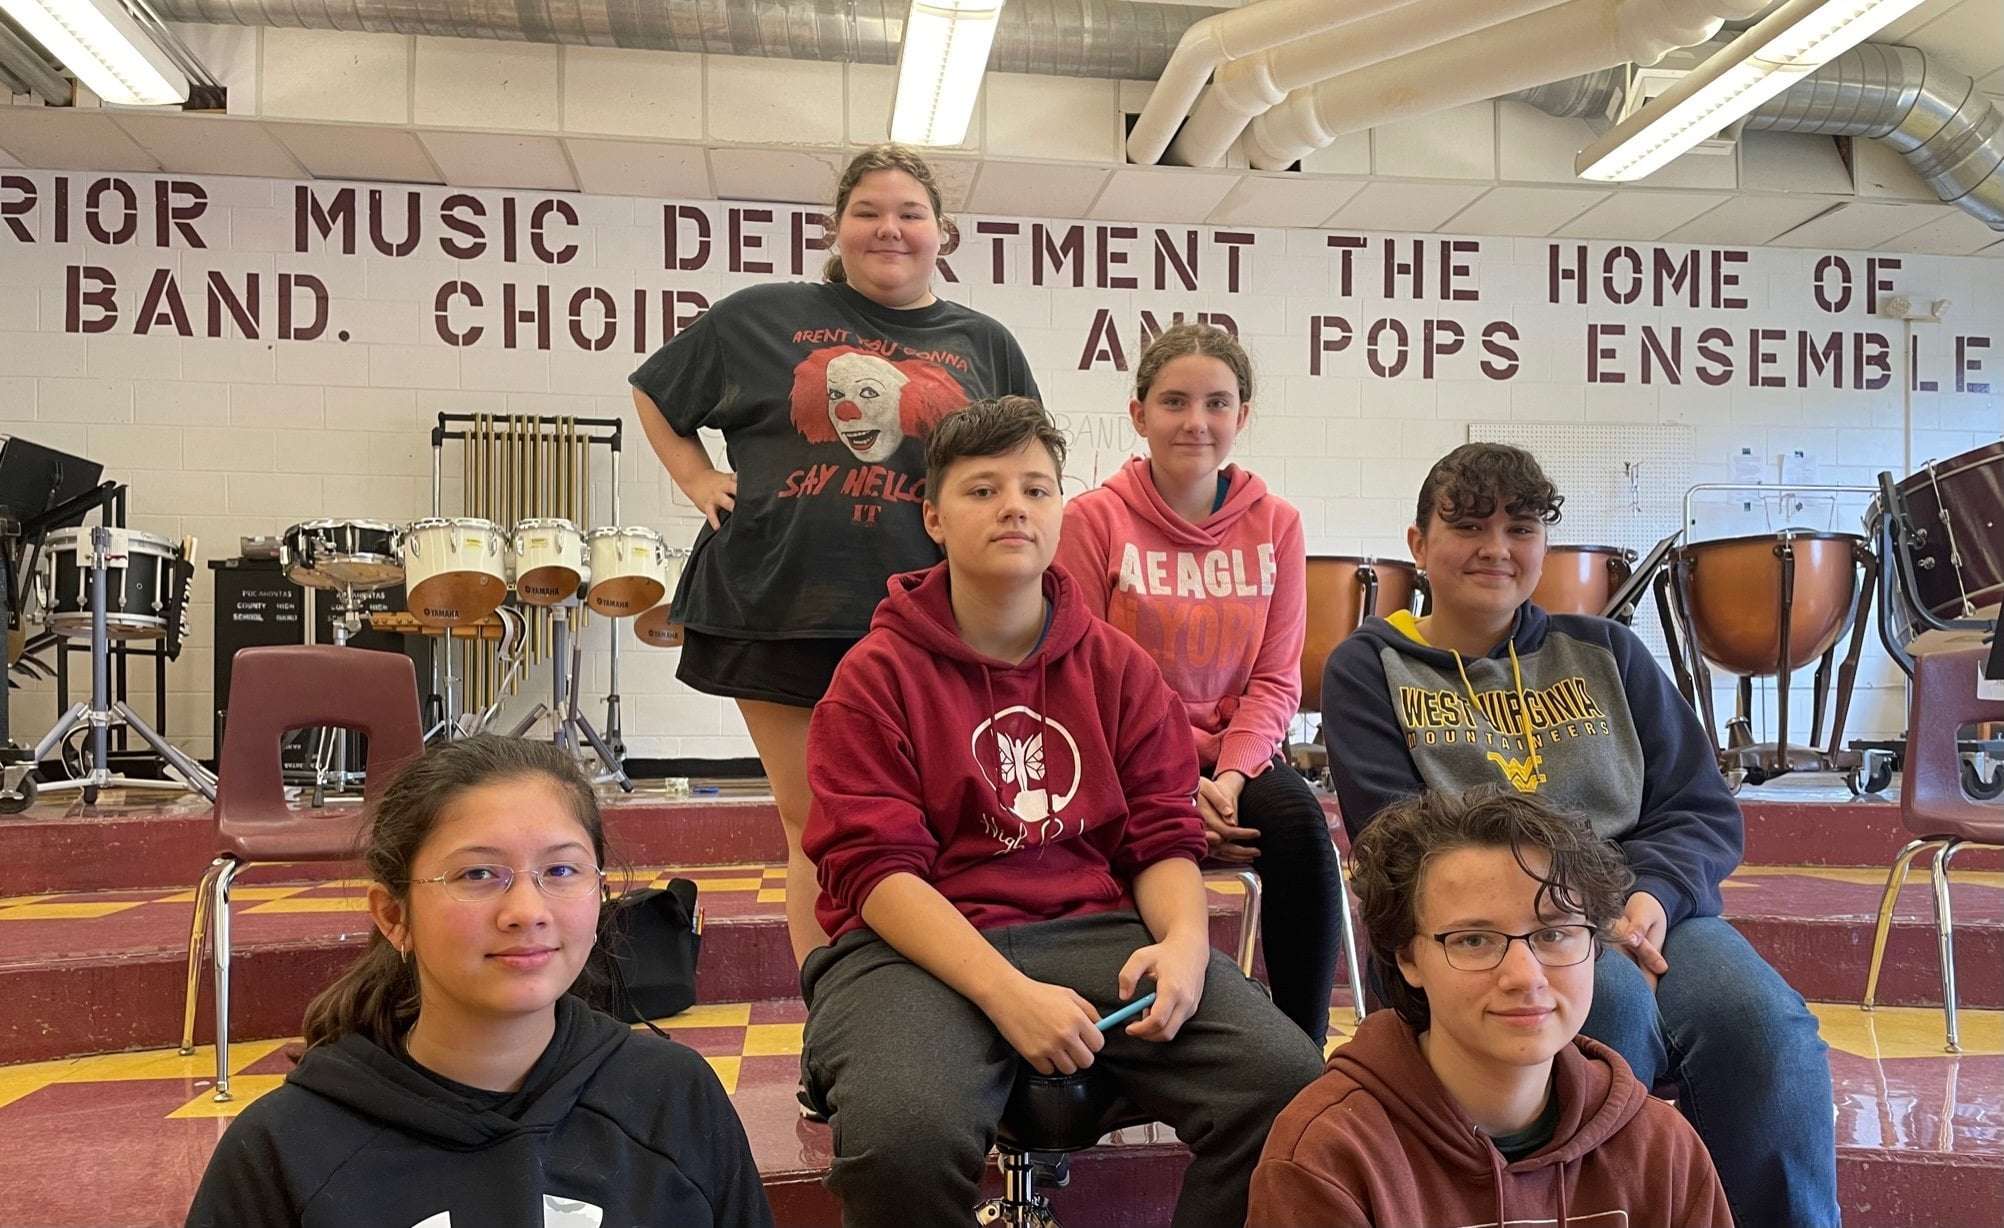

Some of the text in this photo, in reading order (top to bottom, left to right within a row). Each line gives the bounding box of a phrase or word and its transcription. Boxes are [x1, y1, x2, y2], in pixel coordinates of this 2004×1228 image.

[0, 175, 1902, 314] RIOR MUSIC DEPRTMENT THE HOME OF
[65, 265, 351, 342] BAND.
[1310, 315, 1519, 381] POPS
[1587, 324, 1991, 394] ENSEMBLE
[777, 463, 840, 499] SAY
[852, 504, 882, 526] IT
[1119, 542, 1277, 600] AEAGLE
[236, 601, 267, 610] COUNTY
[530, 586, 560, 596] YAMAHA
[429, 607, 460, 618] YAMAHA
[1400, 676, 1606, 736] WEST VIRGINIA
[1407, 720, 1610, 750] MOUNTAINEERS
